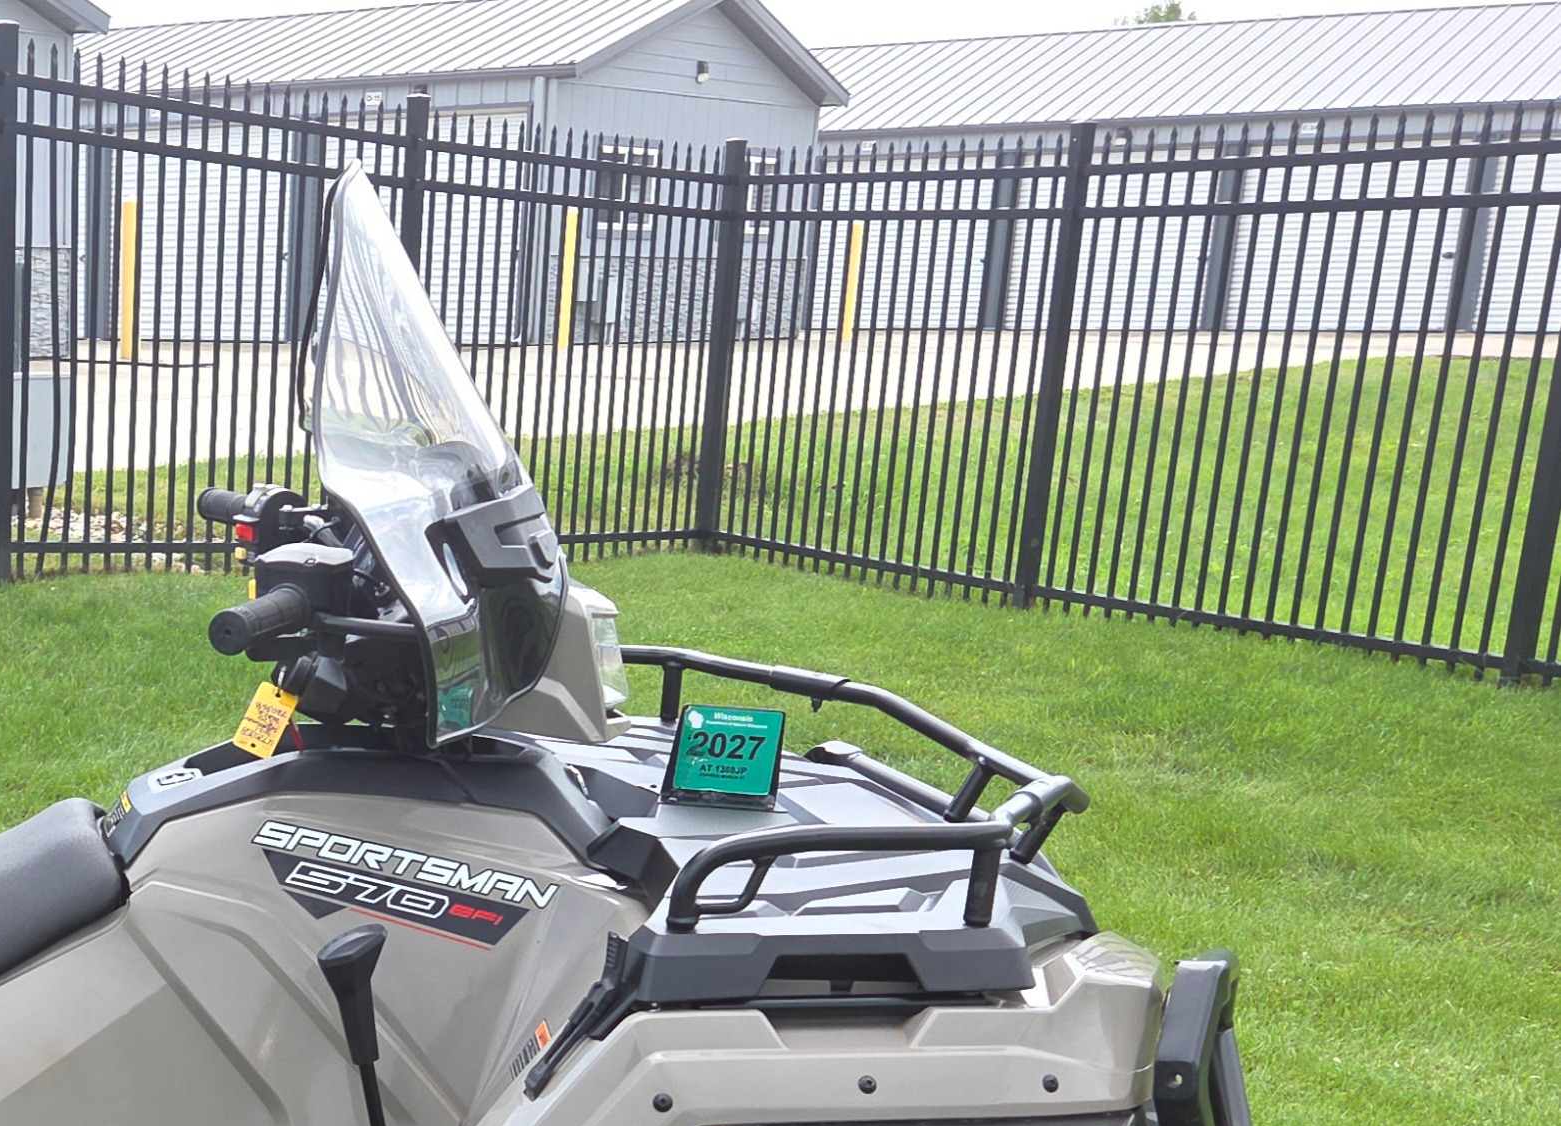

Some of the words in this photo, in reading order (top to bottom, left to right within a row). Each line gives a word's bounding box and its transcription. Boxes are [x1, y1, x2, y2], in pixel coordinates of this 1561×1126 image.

[685, 731, 766, 760] 2027
[252, 820, 558, 909] SPORTSMAN
[285, 861, 449, 919] 570
[448, 903, 504, 926] EFI
